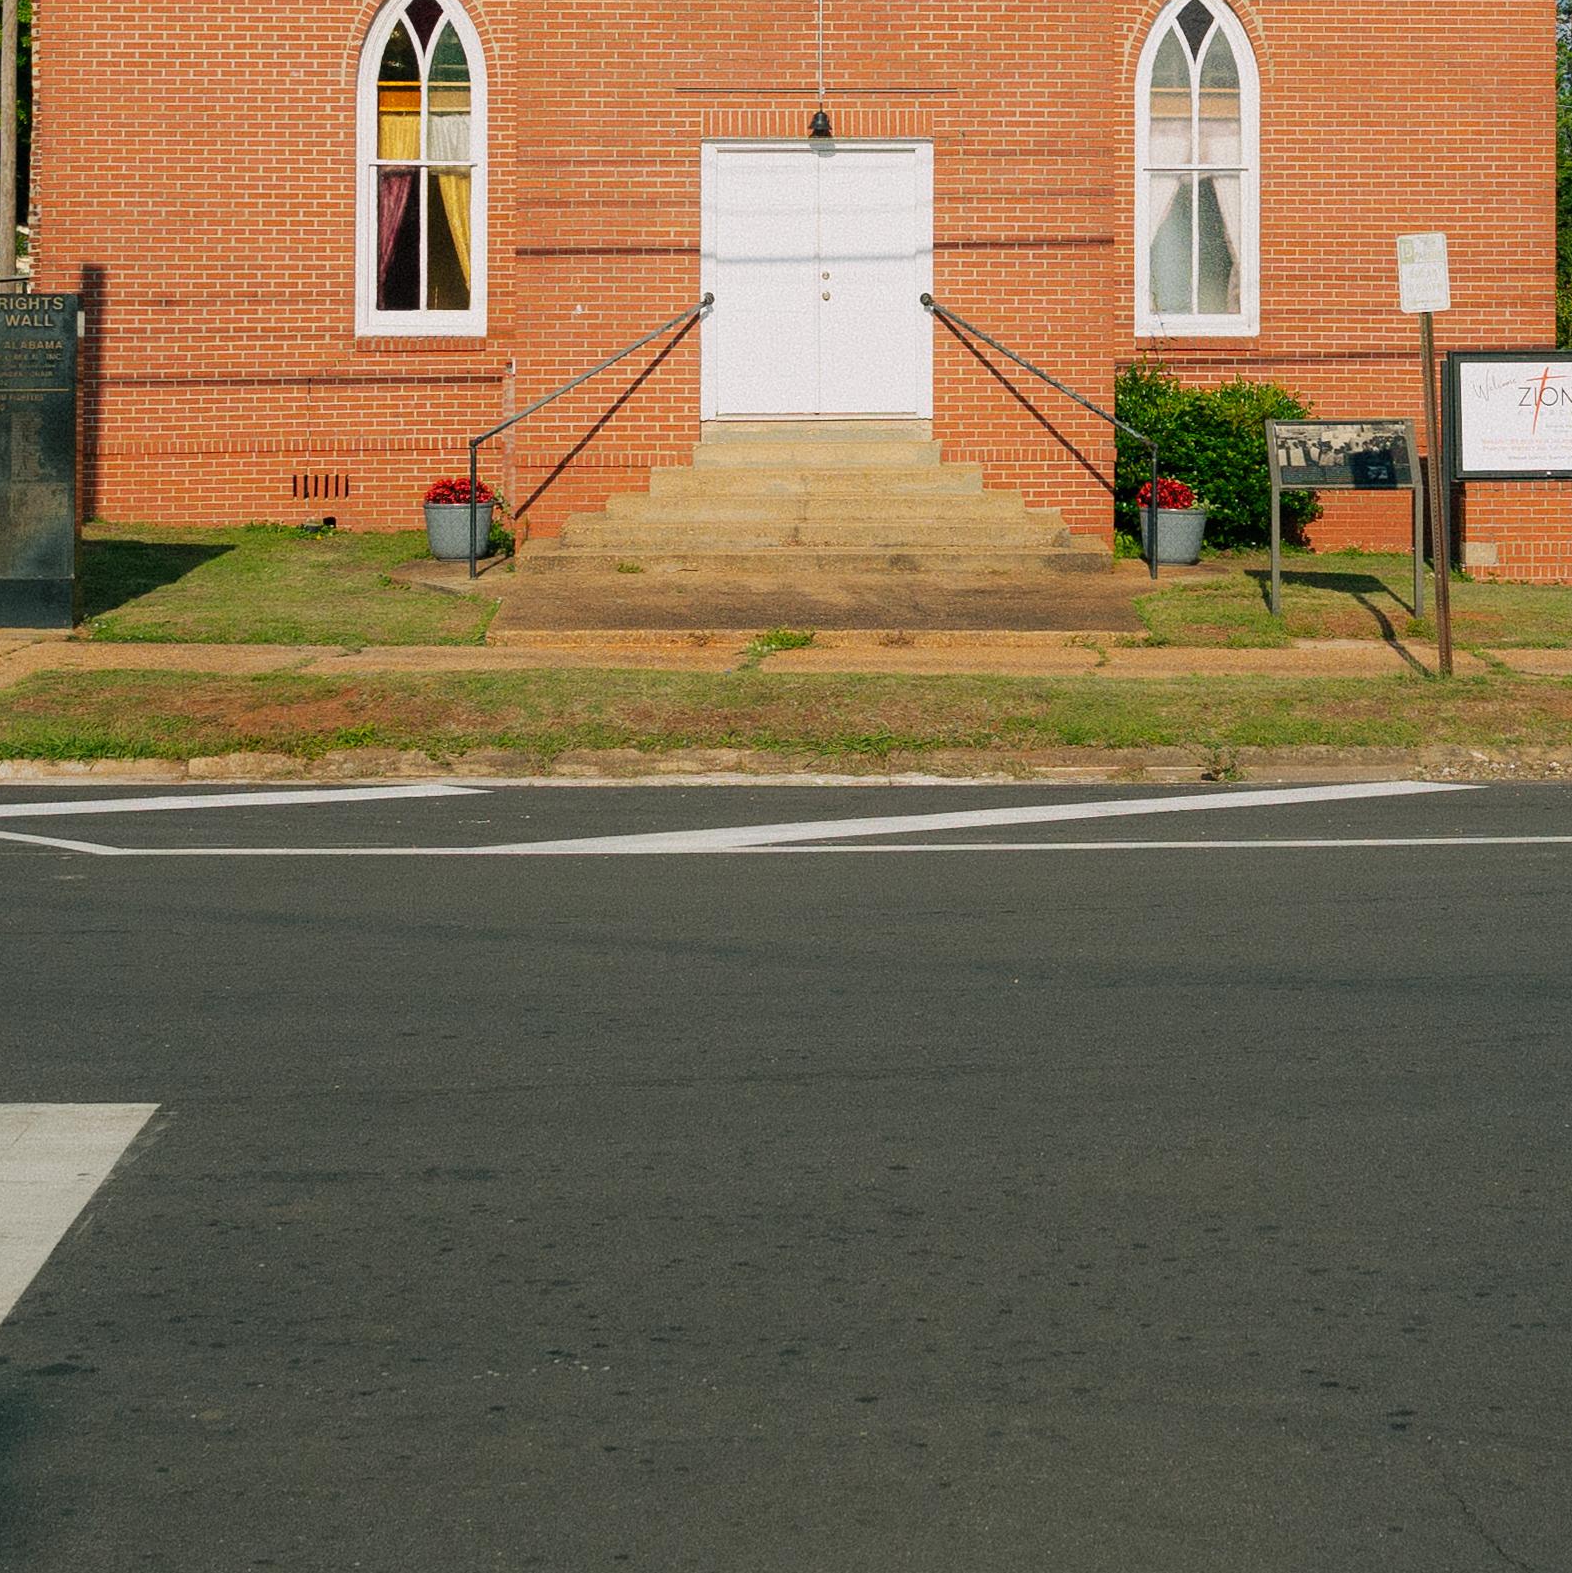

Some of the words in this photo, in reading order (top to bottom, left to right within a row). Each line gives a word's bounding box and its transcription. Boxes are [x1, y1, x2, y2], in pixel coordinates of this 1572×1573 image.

[5, 314, 54, 327] WALL
[3, 340, 64, 350] ALABAMA
[1472, 369, 1517, 402] Welcome
